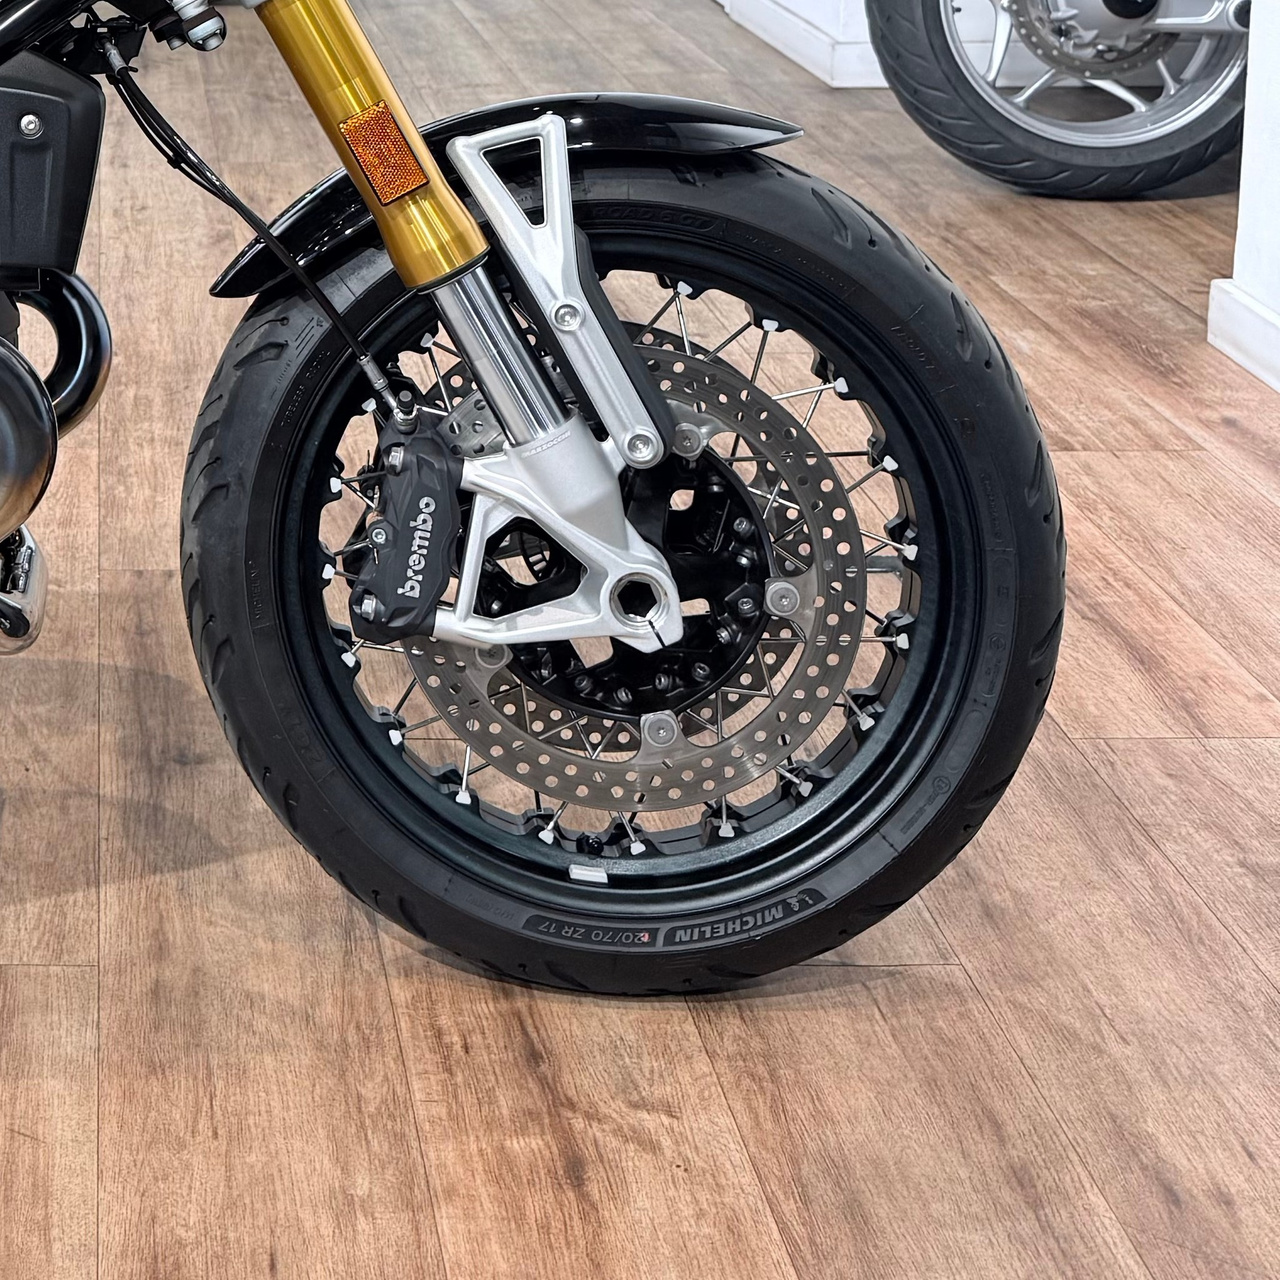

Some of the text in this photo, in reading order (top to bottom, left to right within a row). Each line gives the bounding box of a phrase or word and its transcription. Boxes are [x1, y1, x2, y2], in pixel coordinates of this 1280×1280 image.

[593, 206, 653, 221] ROAD
[521, 430, 571, 459] MARZOCCHI
[397, 496, 436, 599] brembo
[538, 921, 556, 933] 17
[561, 925, 586, 939] ZR
[674, 904, 784, 943] MICHELIN
